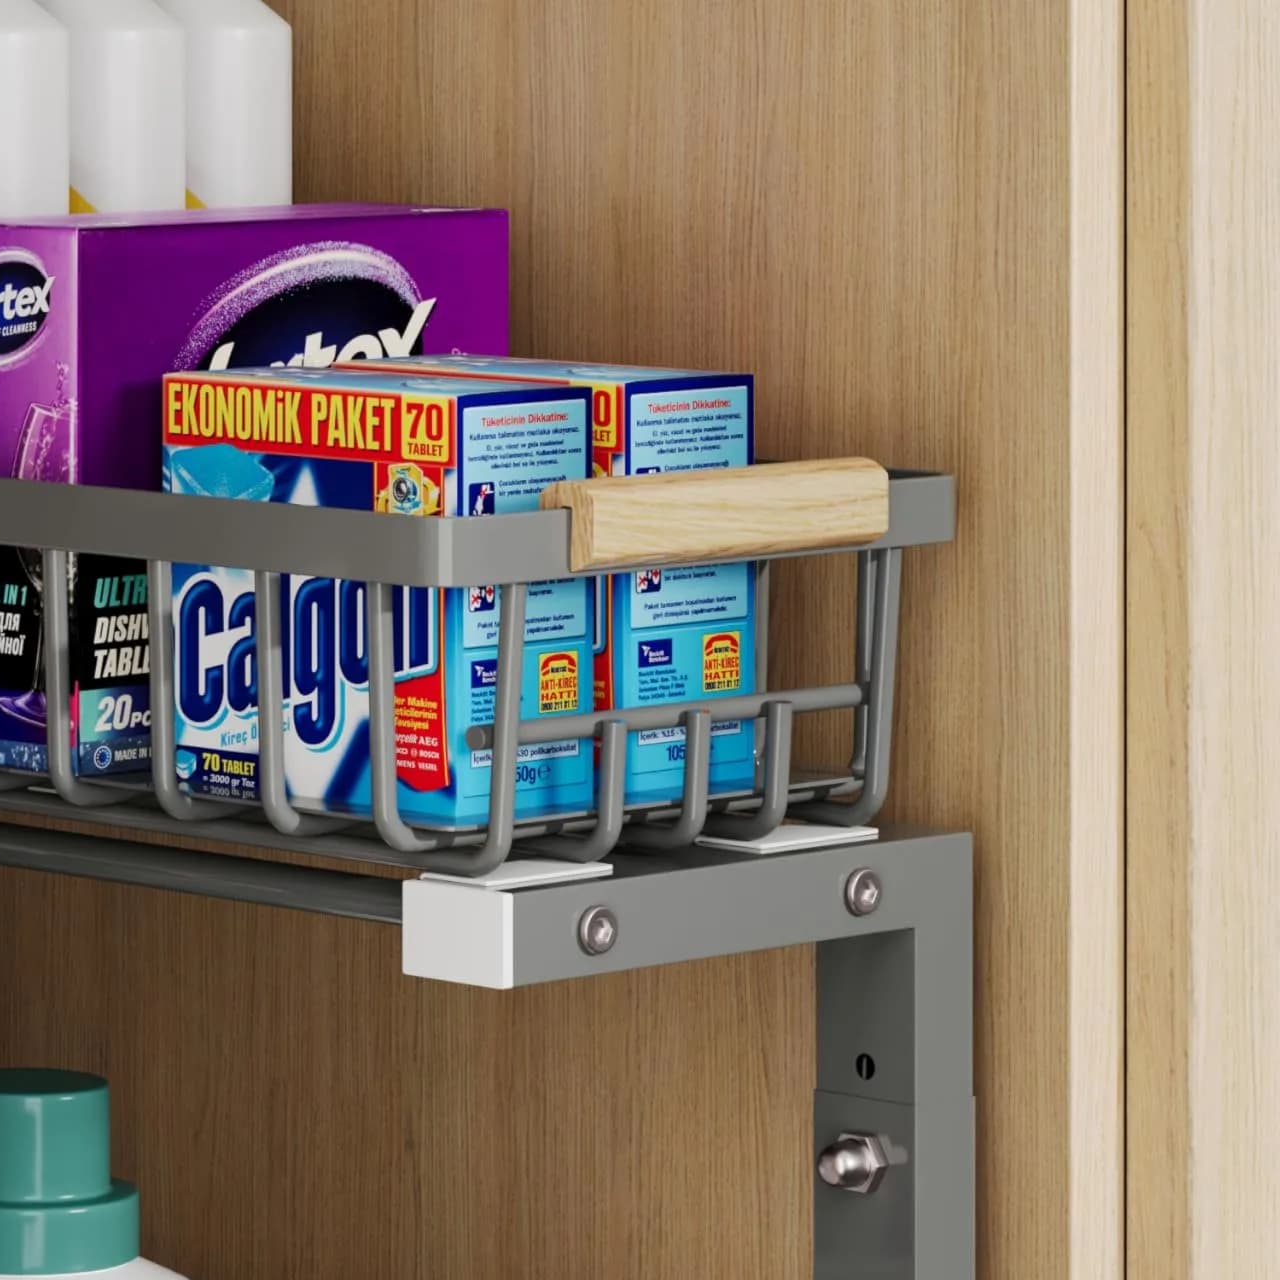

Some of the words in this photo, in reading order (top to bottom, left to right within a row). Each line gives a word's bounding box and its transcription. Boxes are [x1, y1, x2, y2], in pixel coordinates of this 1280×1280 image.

[2, 320, 38, 337] CLEANNESS
[593, 389, 611, 427] 0
[311, 391, 396, 452] PAKET
[405, 402, 444, 441] 70
[407, 443, 444, 457] TABLET
[3, 583, 19, 606] IN
[20, 585, 28, 607] 1
[94, 574, 149, 608] ULTR
[704, 669, 740, 681] HATTI
[407, 695, 438, 710] Makine
[540, 689, 577, 702] HATTI
[94, 694, 151, 733] 20PC
[395, 706, 438, 720] eticilerinin
[418, 735, 439, 748] AEG
[114, 748, 137, 762] MADE
[138, 747, 148, 759] IN
[666, 744, 686, 761] 105
[202, 752, 220, 772] 70
[222, 759, 256, 777] TABLET
[210, 773, 230, 785] 3000
[241, 777, 255, 788] Toz
